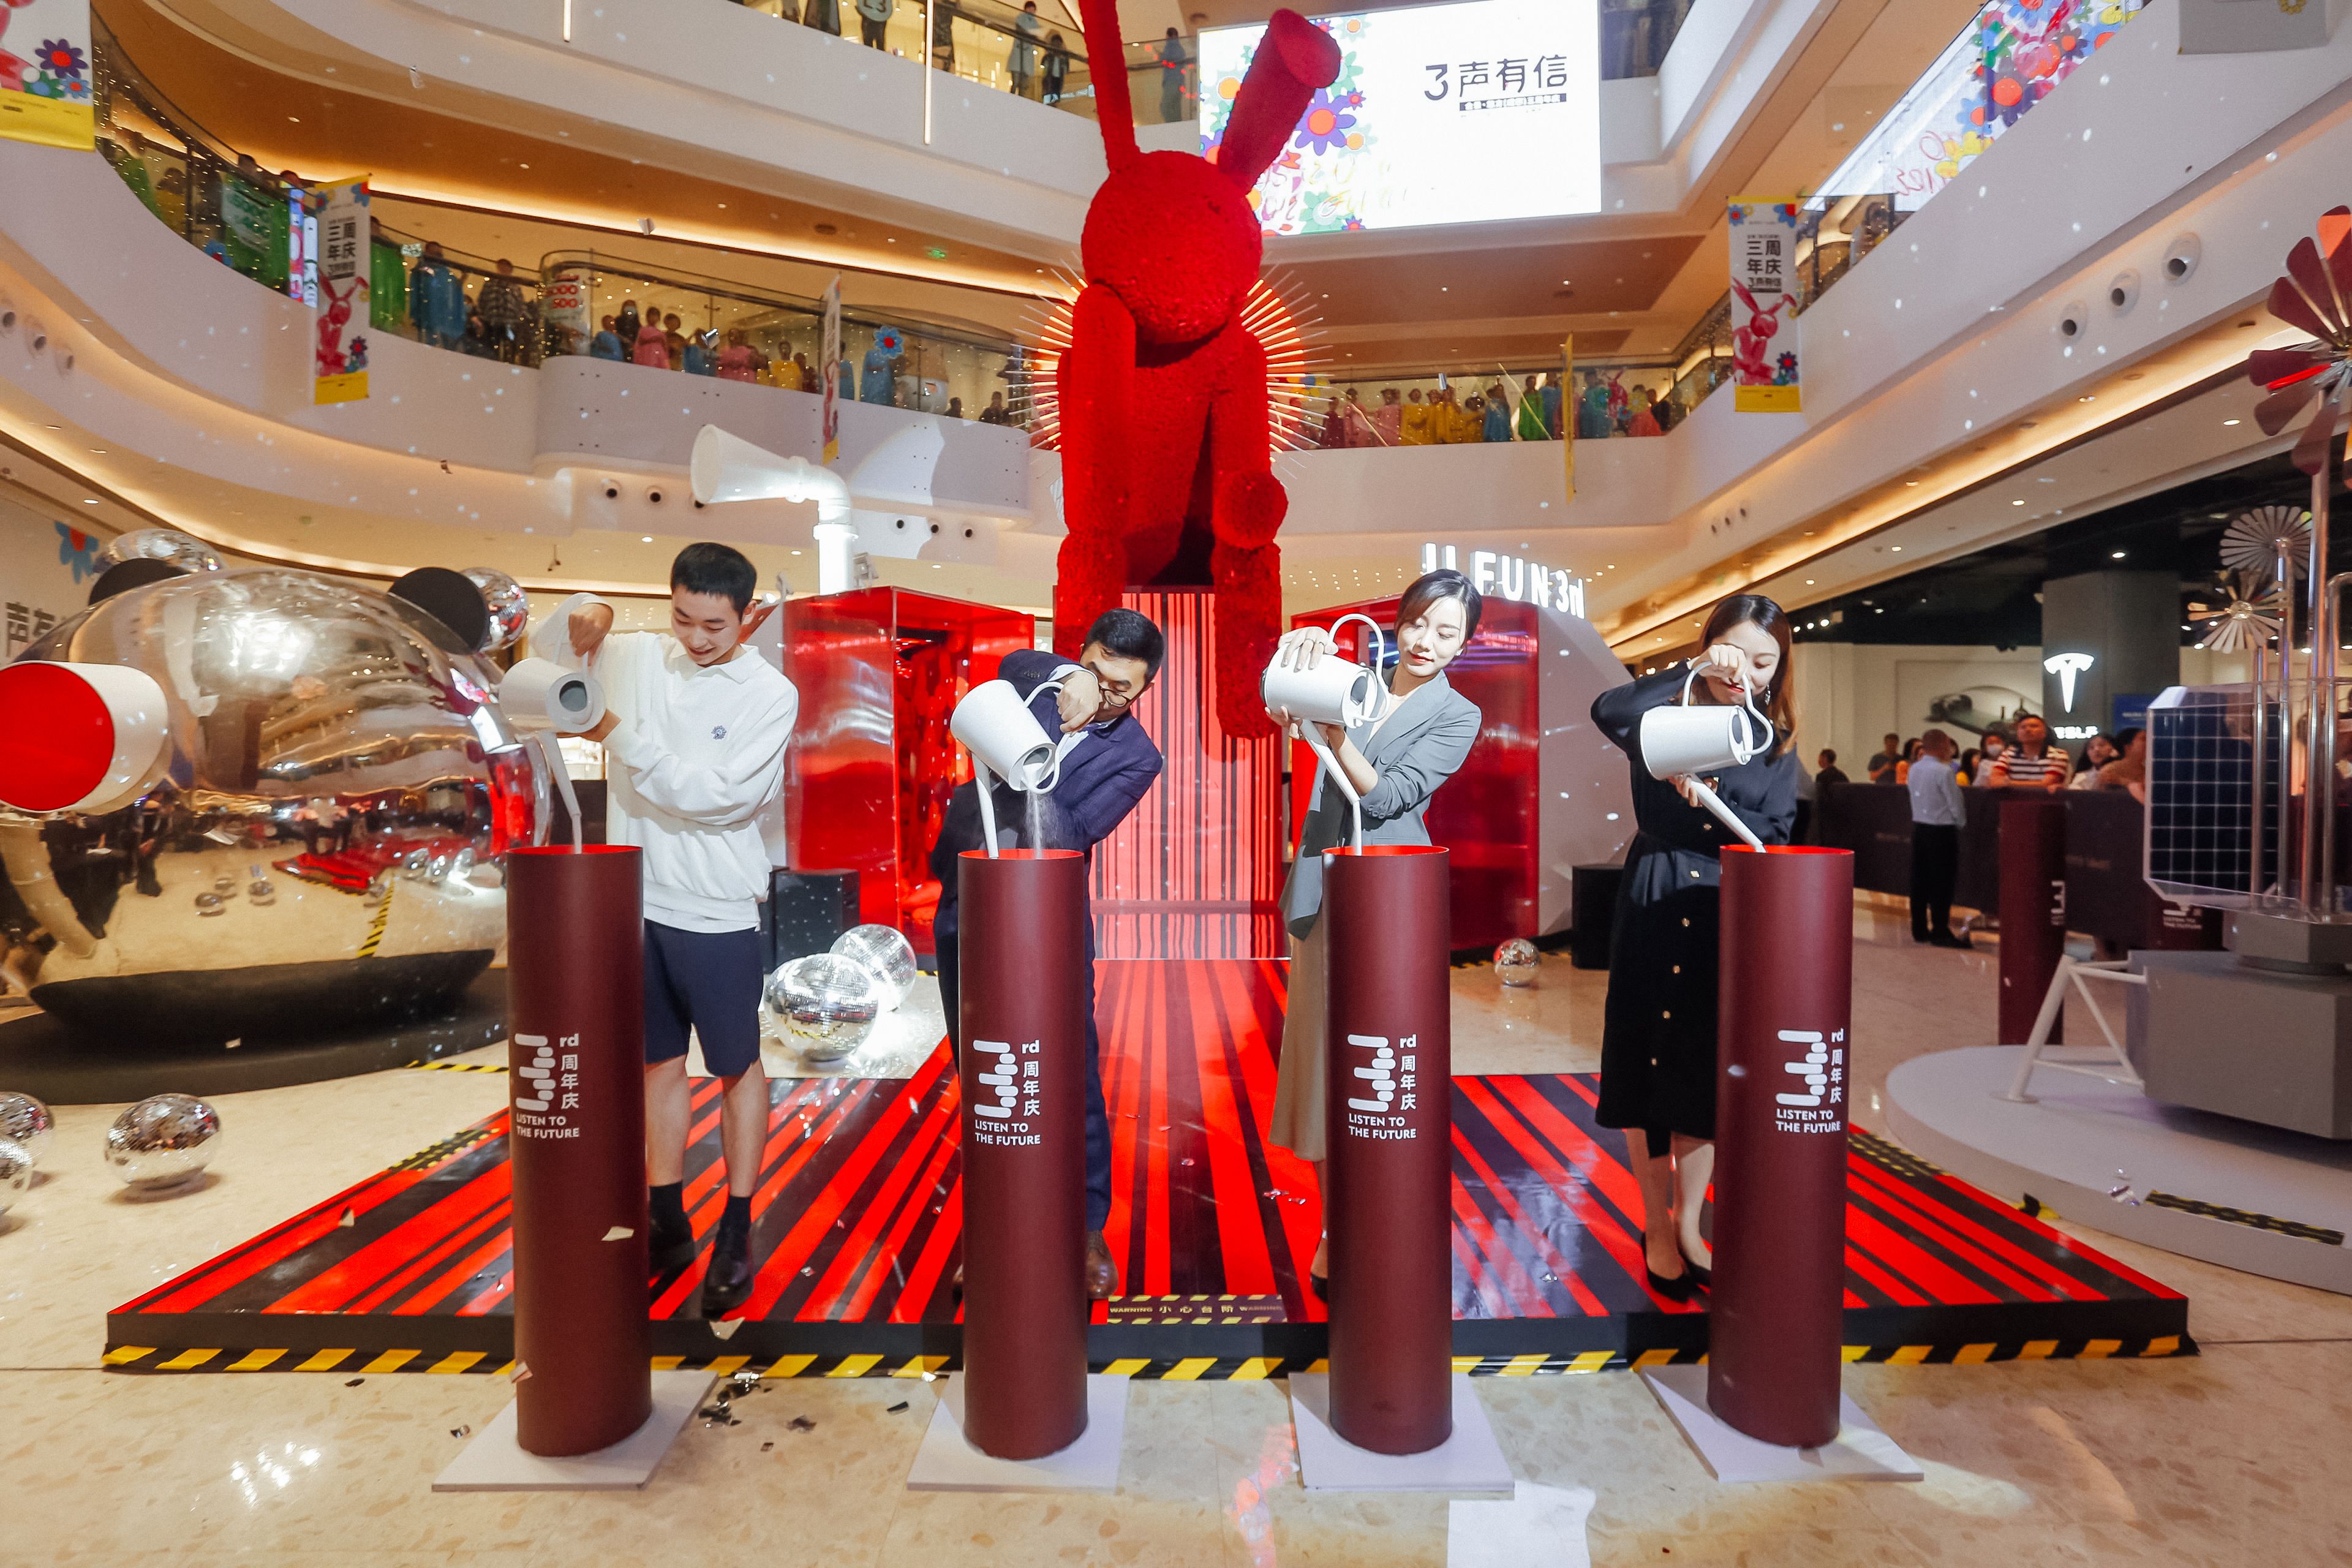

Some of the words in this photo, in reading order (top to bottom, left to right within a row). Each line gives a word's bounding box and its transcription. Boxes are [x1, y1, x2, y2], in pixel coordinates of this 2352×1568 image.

[328, 222, 356, 242] 三周
[328, 242, 356, 260] 年庆
[1747, 240, 1781, 256] 三周
[1747, 258, 1782, 274] 年庆
[560, 1054, 579, 1110] 周年庆
[1400, 1055, 1417, 1110] 周年庆
[1830, 1049, 1843, 1104] 周年庆
[1022, 1060, 1041, 1117] 周年庆
[516, 1113, 546, 1126] LISTEN
[548, 1116, 567, 1126] TO
[1349, 1113, 1385, 1126] LISTEN
[1388, 1117, 1406, 1127] TO
[1776, 1108, 1817, 1120] LISTEN
[1819, 1109, 1834, 1120] TO
[516, 1126, 532, 1137] THE
[533, 1128, 579, 1139] FUTURE
[974, 1120, 1008, 1133] LISTEN
[1011, 1123, 1029, 1133] TO
[1348, 1126, 1370, 1138] THE
[1373, 1128, 1417, 1140] FUTURE
[1775, 1120, 1801, 1133] THE
[1803, 1120, 1842, 1134] FUTURE
[974, 1133, 993, 1145] THE
[996, 1134, 1041, 1146] FUTURE
